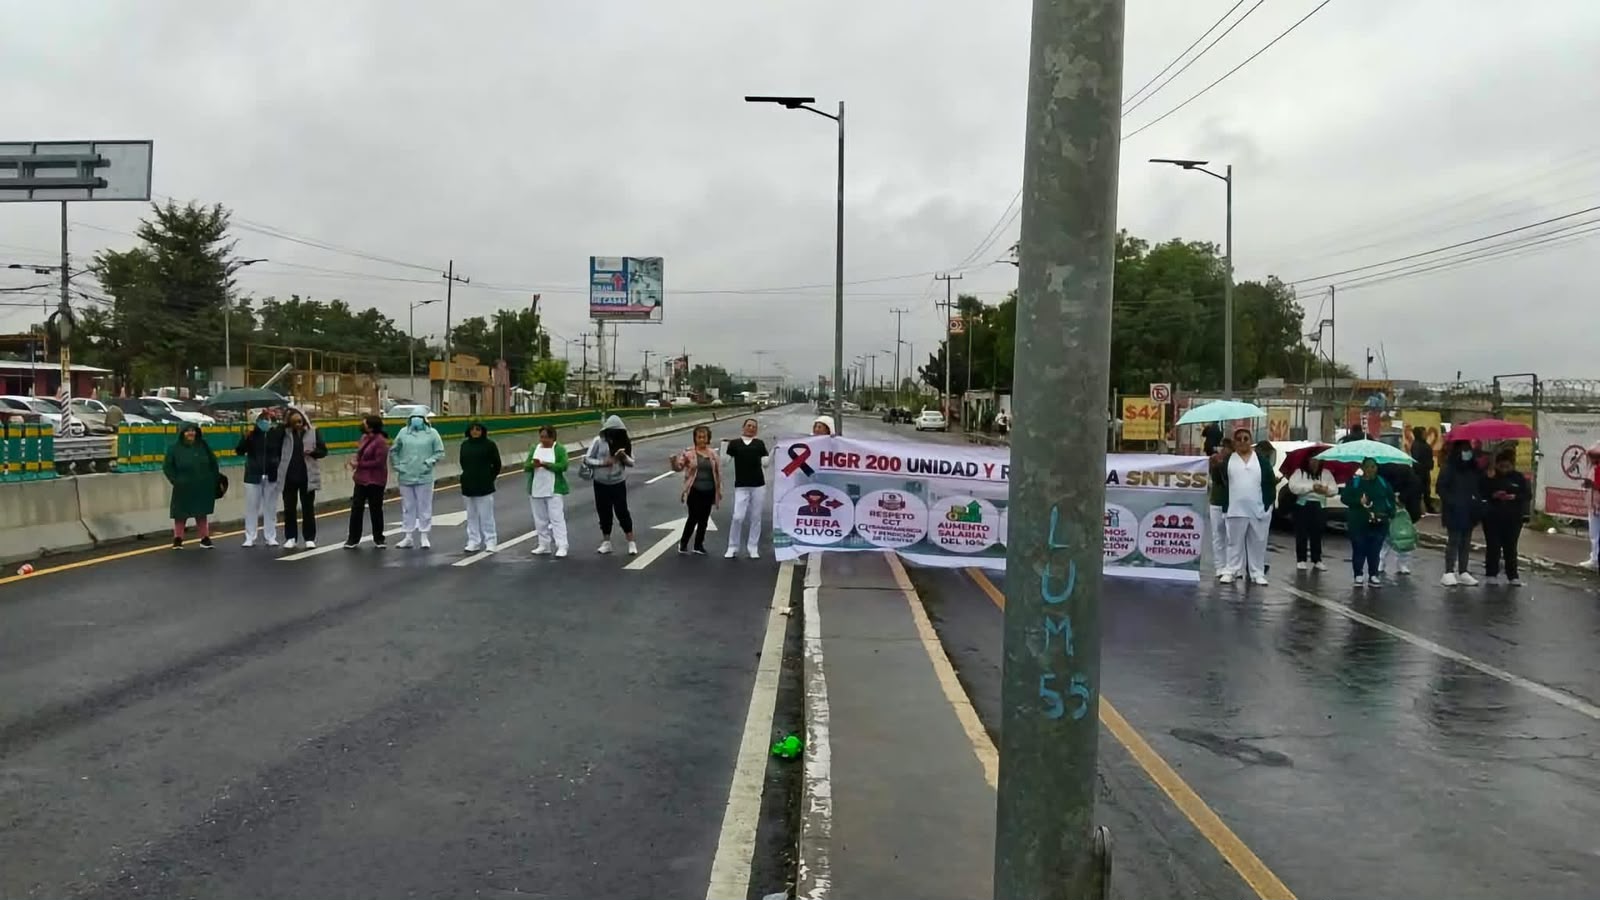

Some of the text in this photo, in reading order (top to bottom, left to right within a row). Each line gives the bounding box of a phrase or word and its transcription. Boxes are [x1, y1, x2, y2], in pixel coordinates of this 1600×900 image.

[1126, 405, 1161, 420] $42
[820, 451, 861, 469] HGR
[866, 454, 901, 472] 200
[907, 457, 978, 477] UNIDAD
[984, 463, 995, 479] Y
[1126, 470, 1207, 488] SNTSS
[869, 510, 915, 520] RESPETO
[796, 518, 840, 528] FUERA
[937, 522, 990, 531] AUMENTO
[793, 527, 843, 537] OLIVOS
[938, 529, 987, 539] SALARIAL
[1145, 531, 1200, 540] CONTRATO
[940, 537, 961, 545] DEL
[1145, 546, 1198, 556] PERSONAL
[1039, 672, 1091, 719] 55
